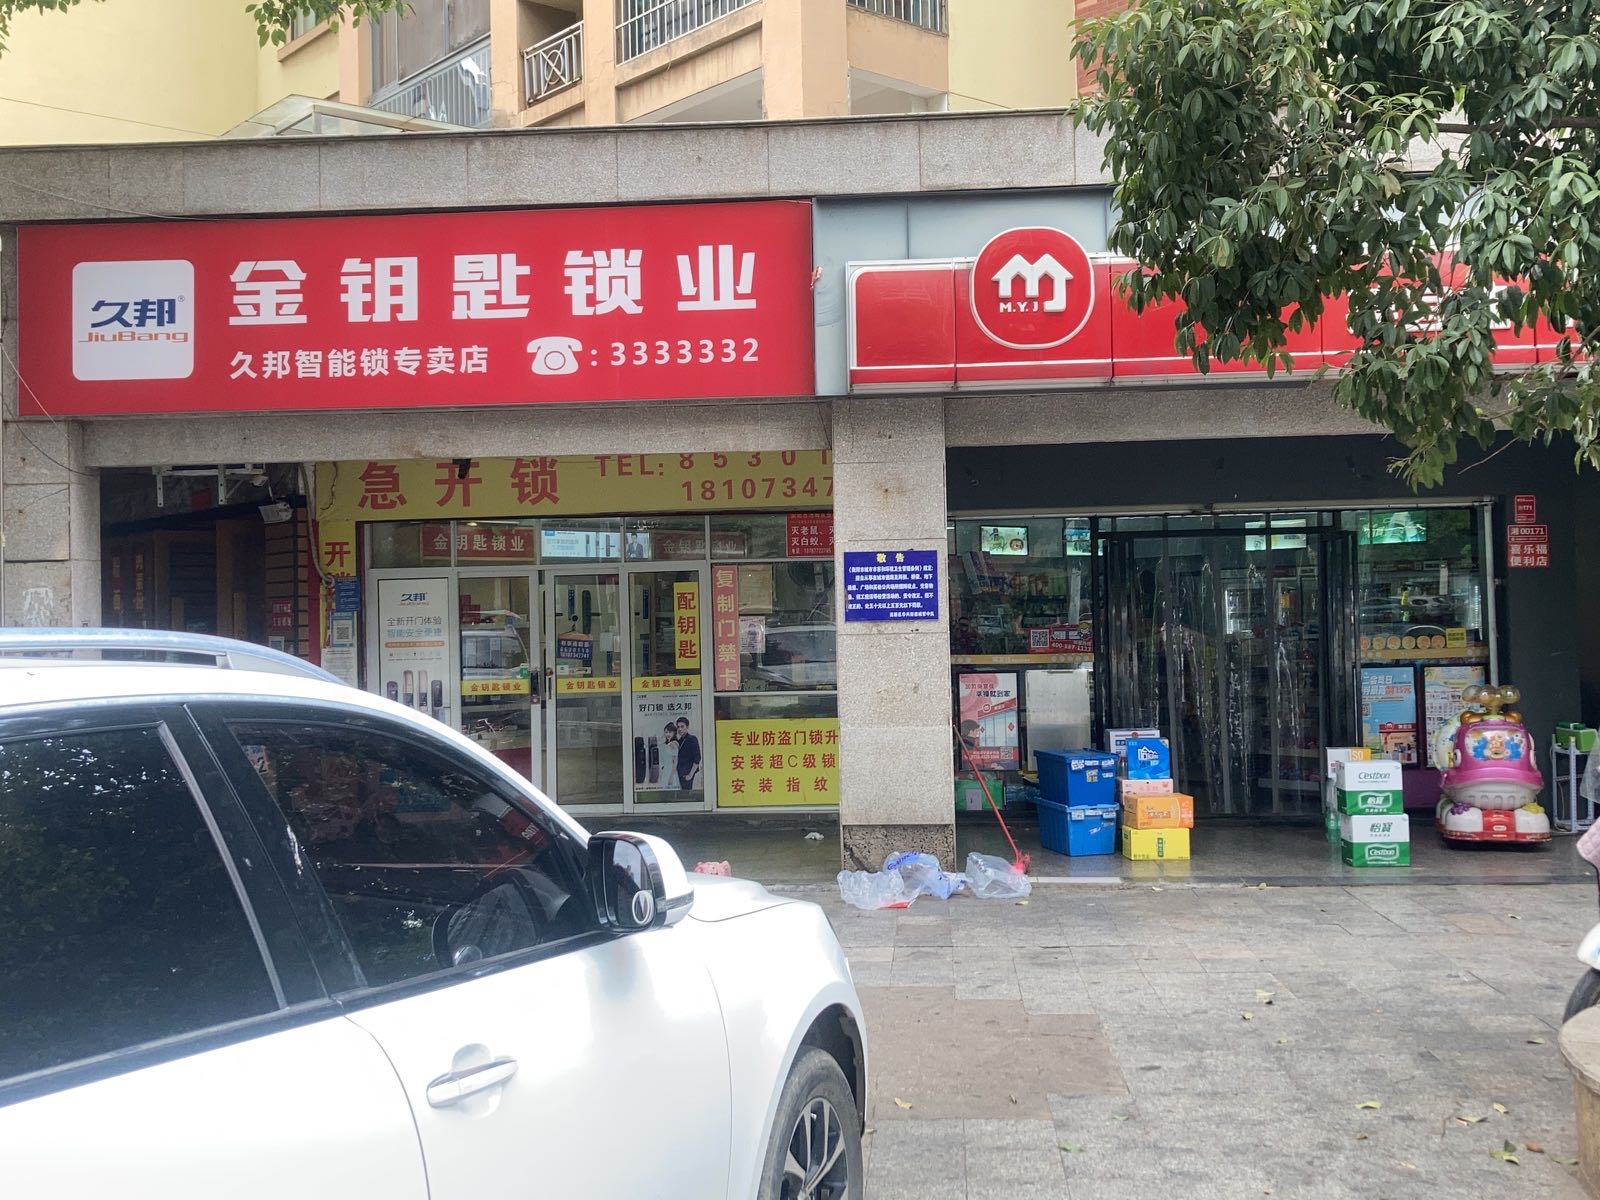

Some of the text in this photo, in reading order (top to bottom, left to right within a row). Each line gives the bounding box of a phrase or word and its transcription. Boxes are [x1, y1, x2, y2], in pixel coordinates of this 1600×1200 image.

[228, 244, 757, 325] 金钥匙锁业
[90, 298, 177, 328] 久邦
[78, 330, 189, 344] JiuBang
[229, 345, 489, 380] 久邦智能锁专卖店
[594, 455, 665, 477] TEL:
[1510, 556, 1548, 567] 便利店
[676, 591, 697, 659] 配钥匙
[716, 569, 738, 687] 复制门禁卡
[730, 729, 839, 746] 专业防盗门锁升
[730, 753, 837, 770] 安装超C级锁
[731, 776, 829, 794] 安装指纹
